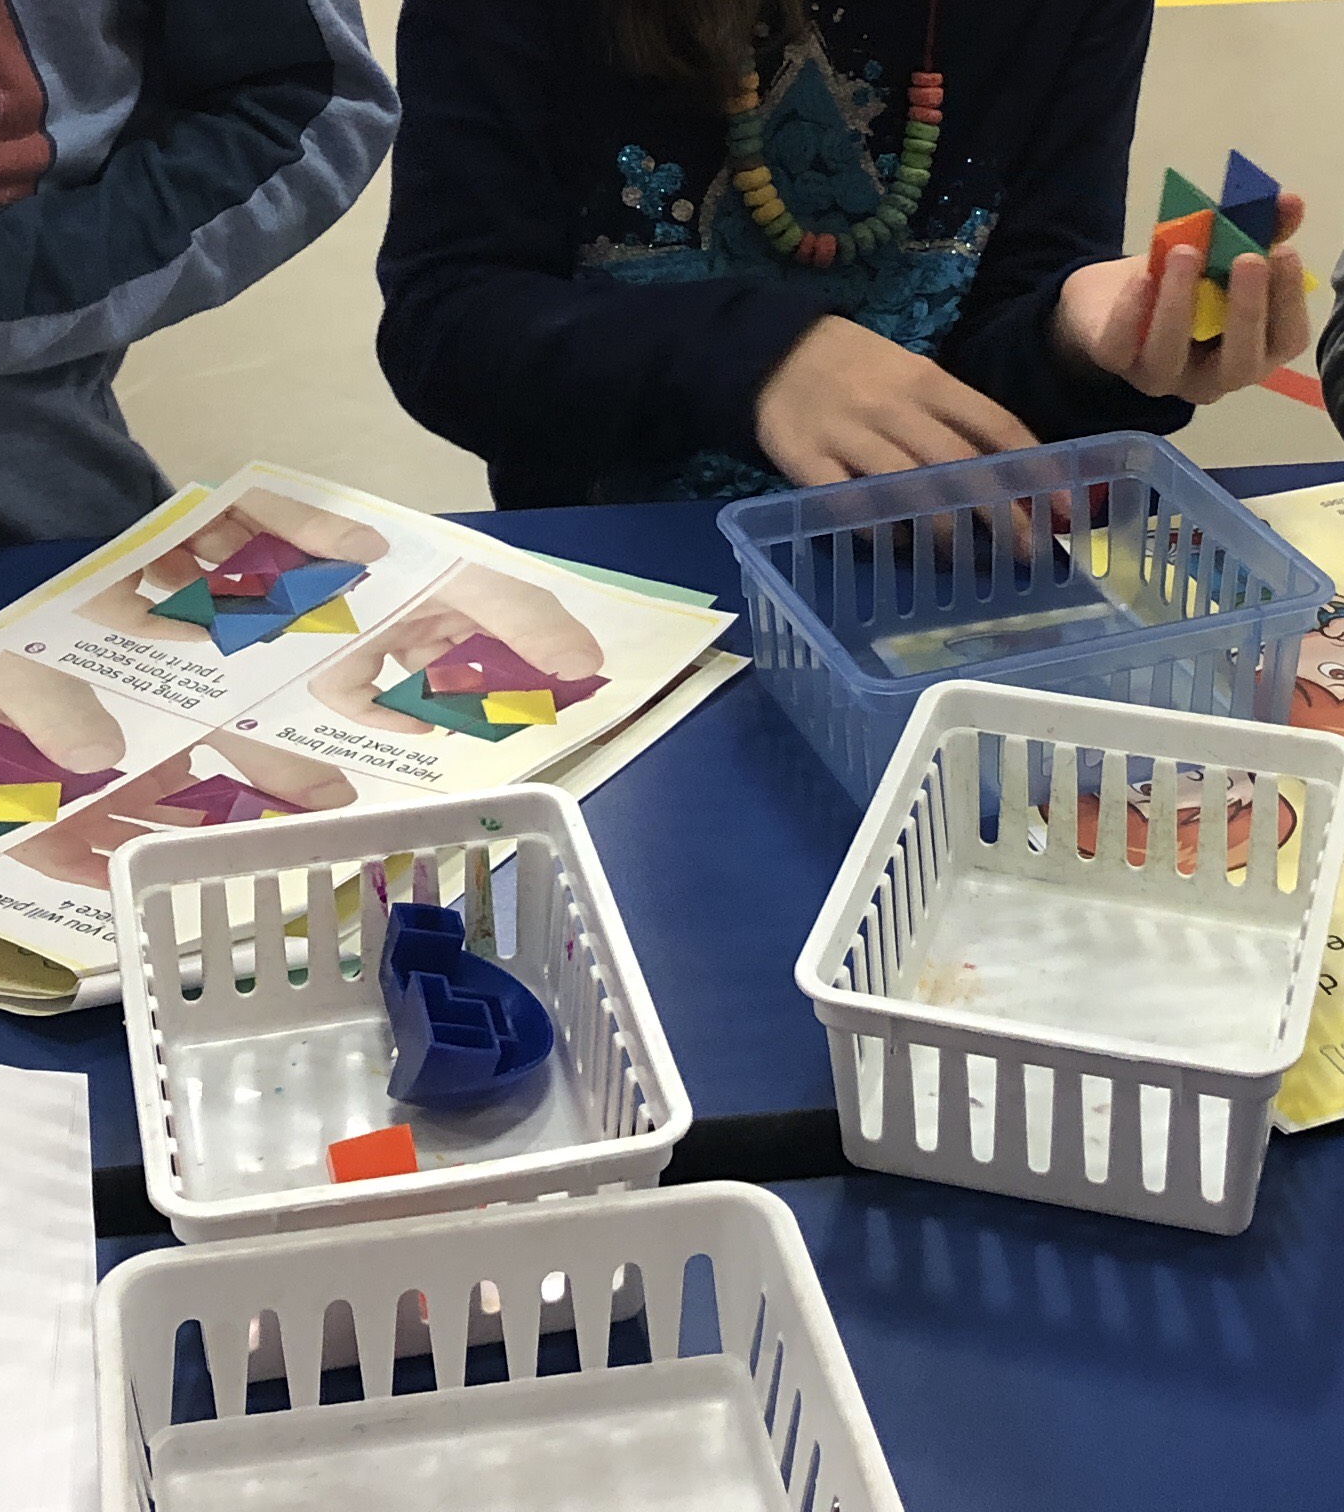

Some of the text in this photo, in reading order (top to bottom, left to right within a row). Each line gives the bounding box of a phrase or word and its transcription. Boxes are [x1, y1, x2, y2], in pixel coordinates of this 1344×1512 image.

[56, 651, 201, 710] Bring the second
[72, 639, 229, 700] piece from section
[102, 633, 225, 686] 1 put it in place
[275, 726, 444, 784] Here you will bring
[312, 723, 440, 768] the next piece
[22, 906, 64, 924] will
[58, 898, 77, 911] 4
[62, 917, 105, 937] you
[1317, 972, 1339, 997] d
